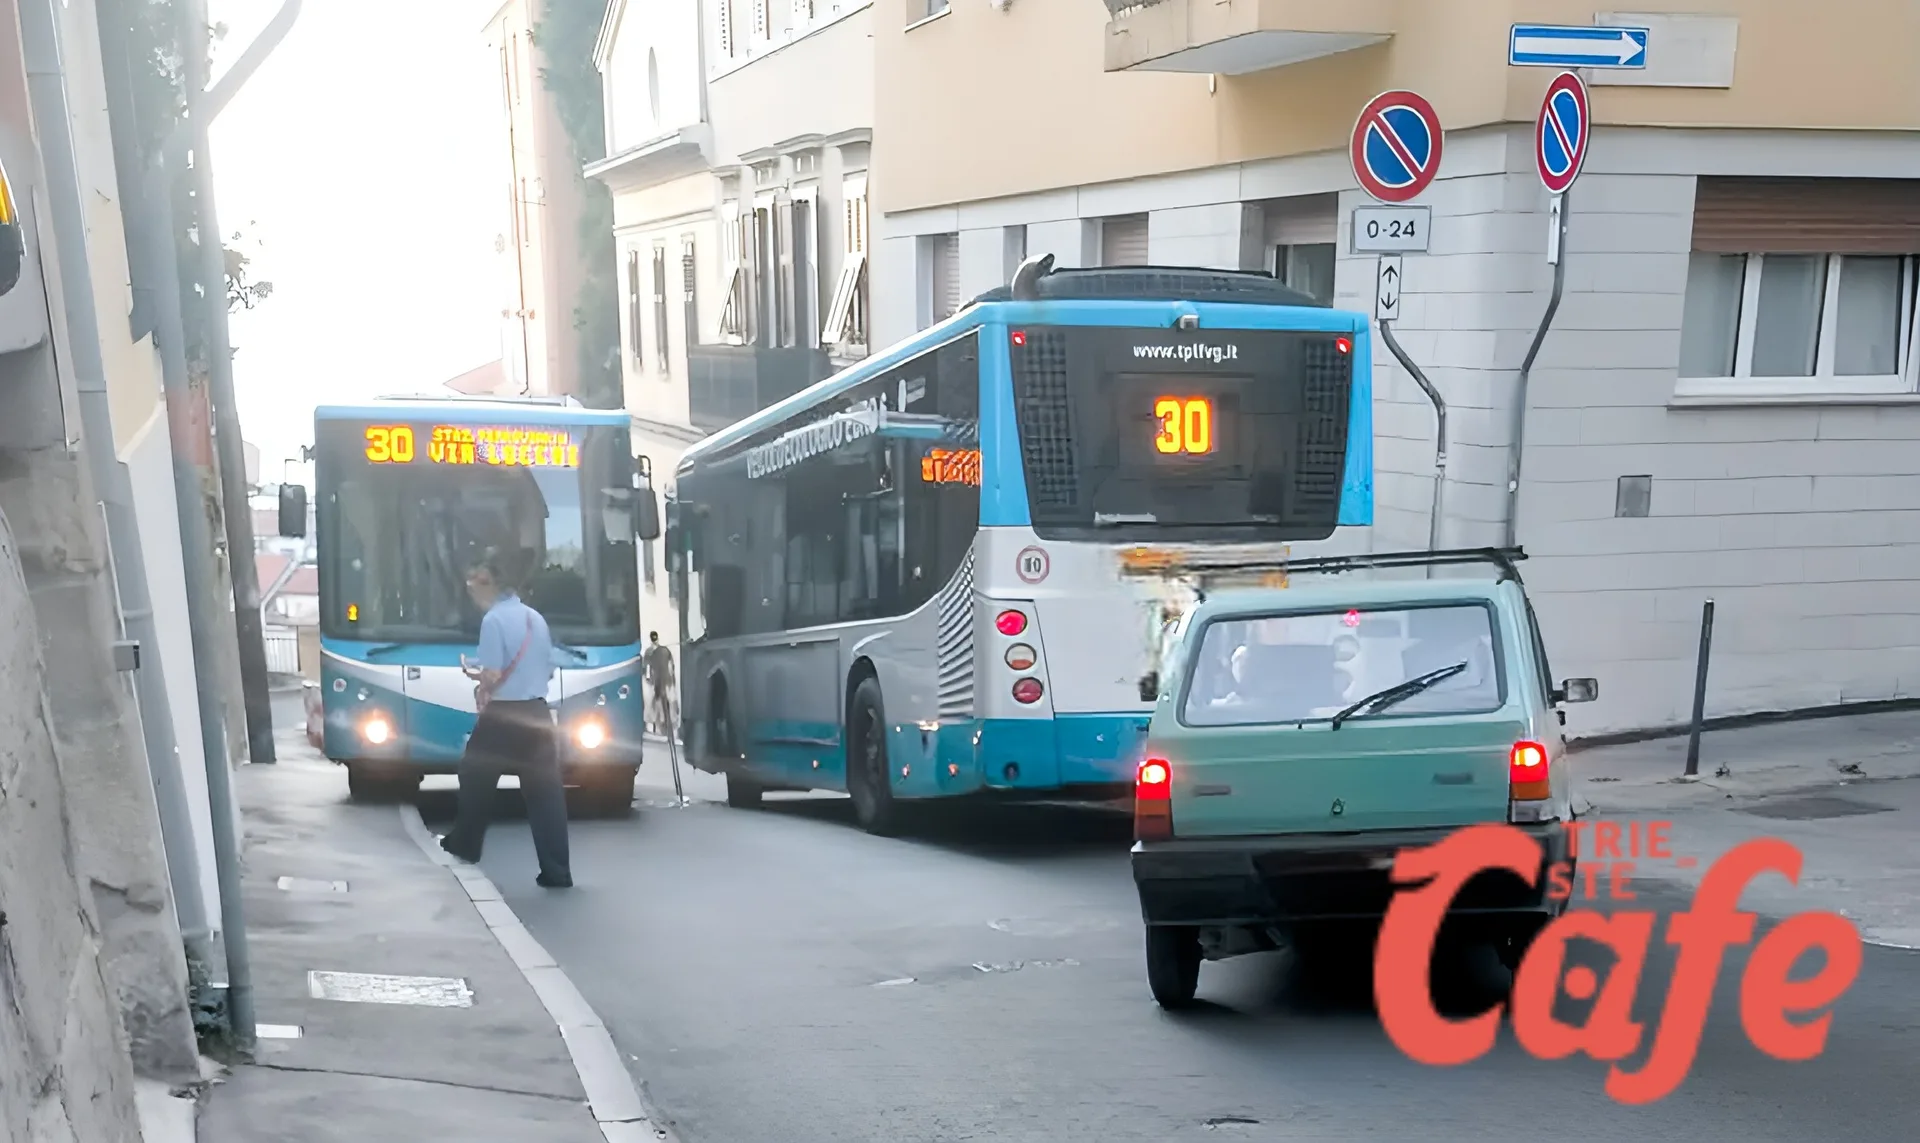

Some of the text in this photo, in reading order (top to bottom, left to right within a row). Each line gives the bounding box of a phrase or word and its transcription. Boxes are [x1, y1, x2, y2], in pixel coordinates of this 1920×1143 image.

[1367, 220, 1415, 238] 0-24
[1133, 343, 1238, 363] www.tplfvg.it
[1154, 397, 1212, 455] 30
[365, 425, 414, 463] 30
